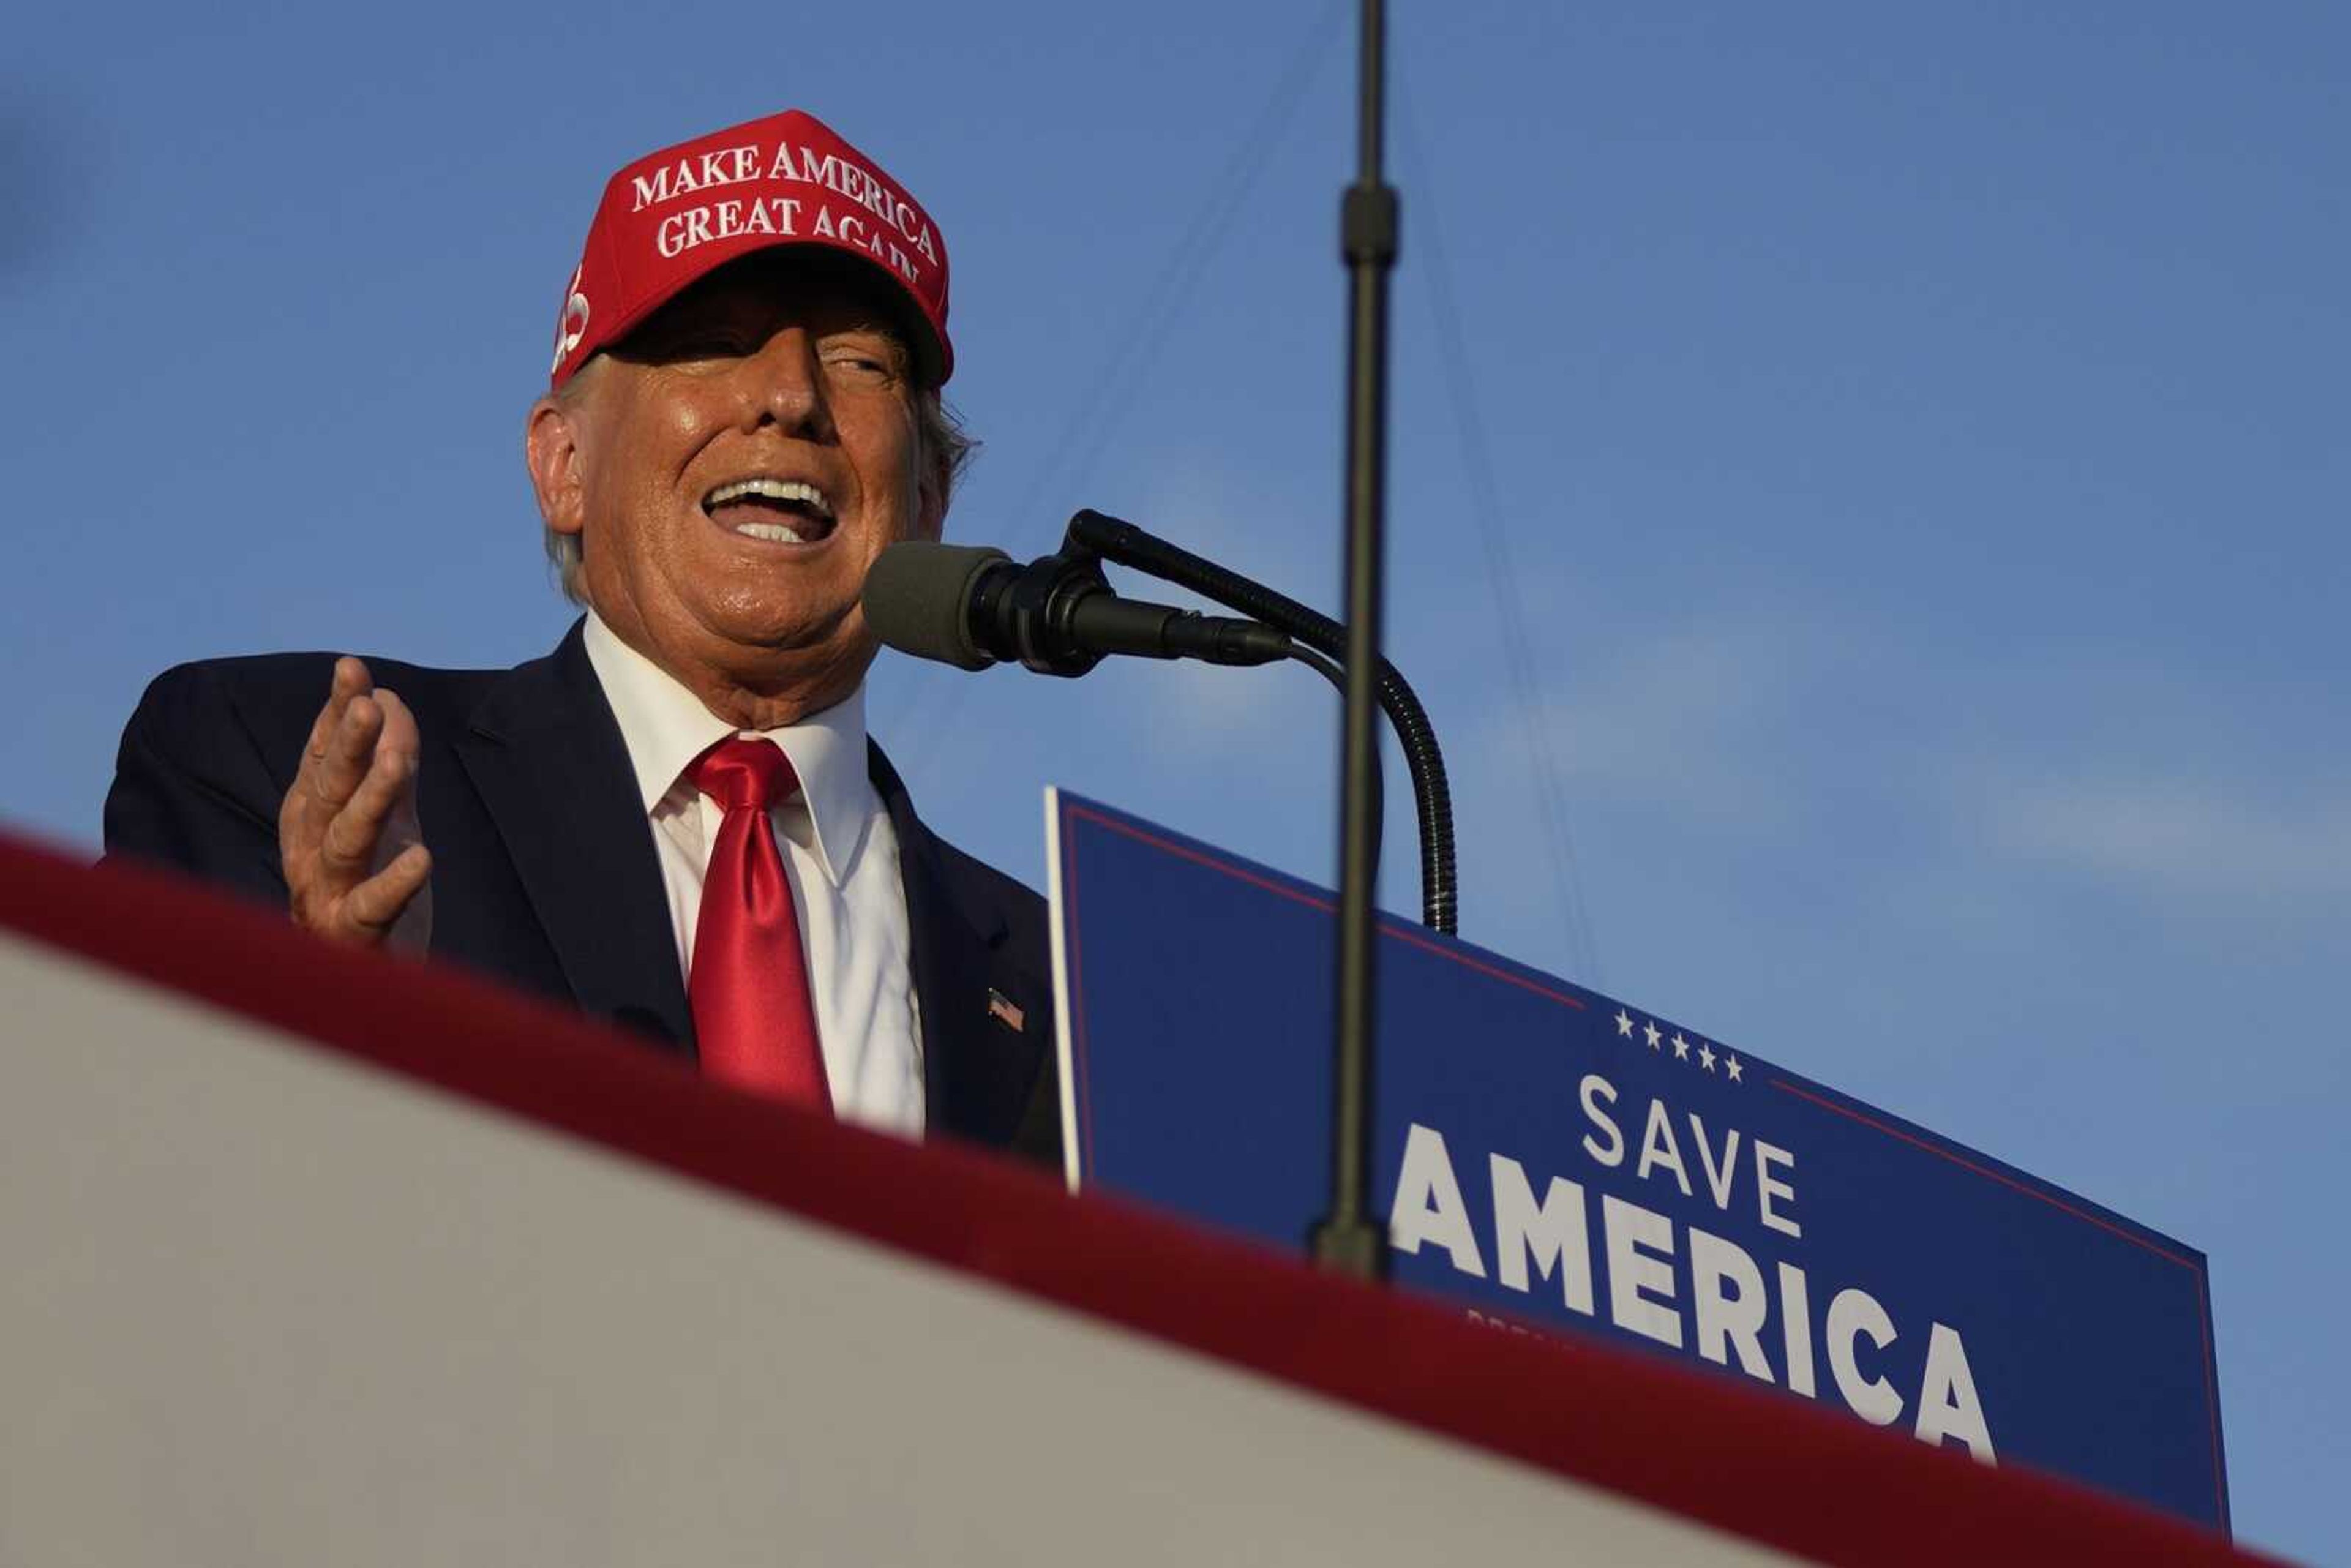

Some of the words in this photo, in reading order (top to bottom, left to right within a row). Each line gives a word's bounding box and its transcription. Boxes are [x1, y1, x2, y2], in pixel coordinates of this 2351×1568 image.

[632, 144, 762, 212] MAKE
[768, 141, 938, 267] AMERICA
[658, 197, 801, 258] GREAT
[1580, 1075, 1801, 1238] SAVE
[1388, 1122, 1998, 1468] AMERICA
